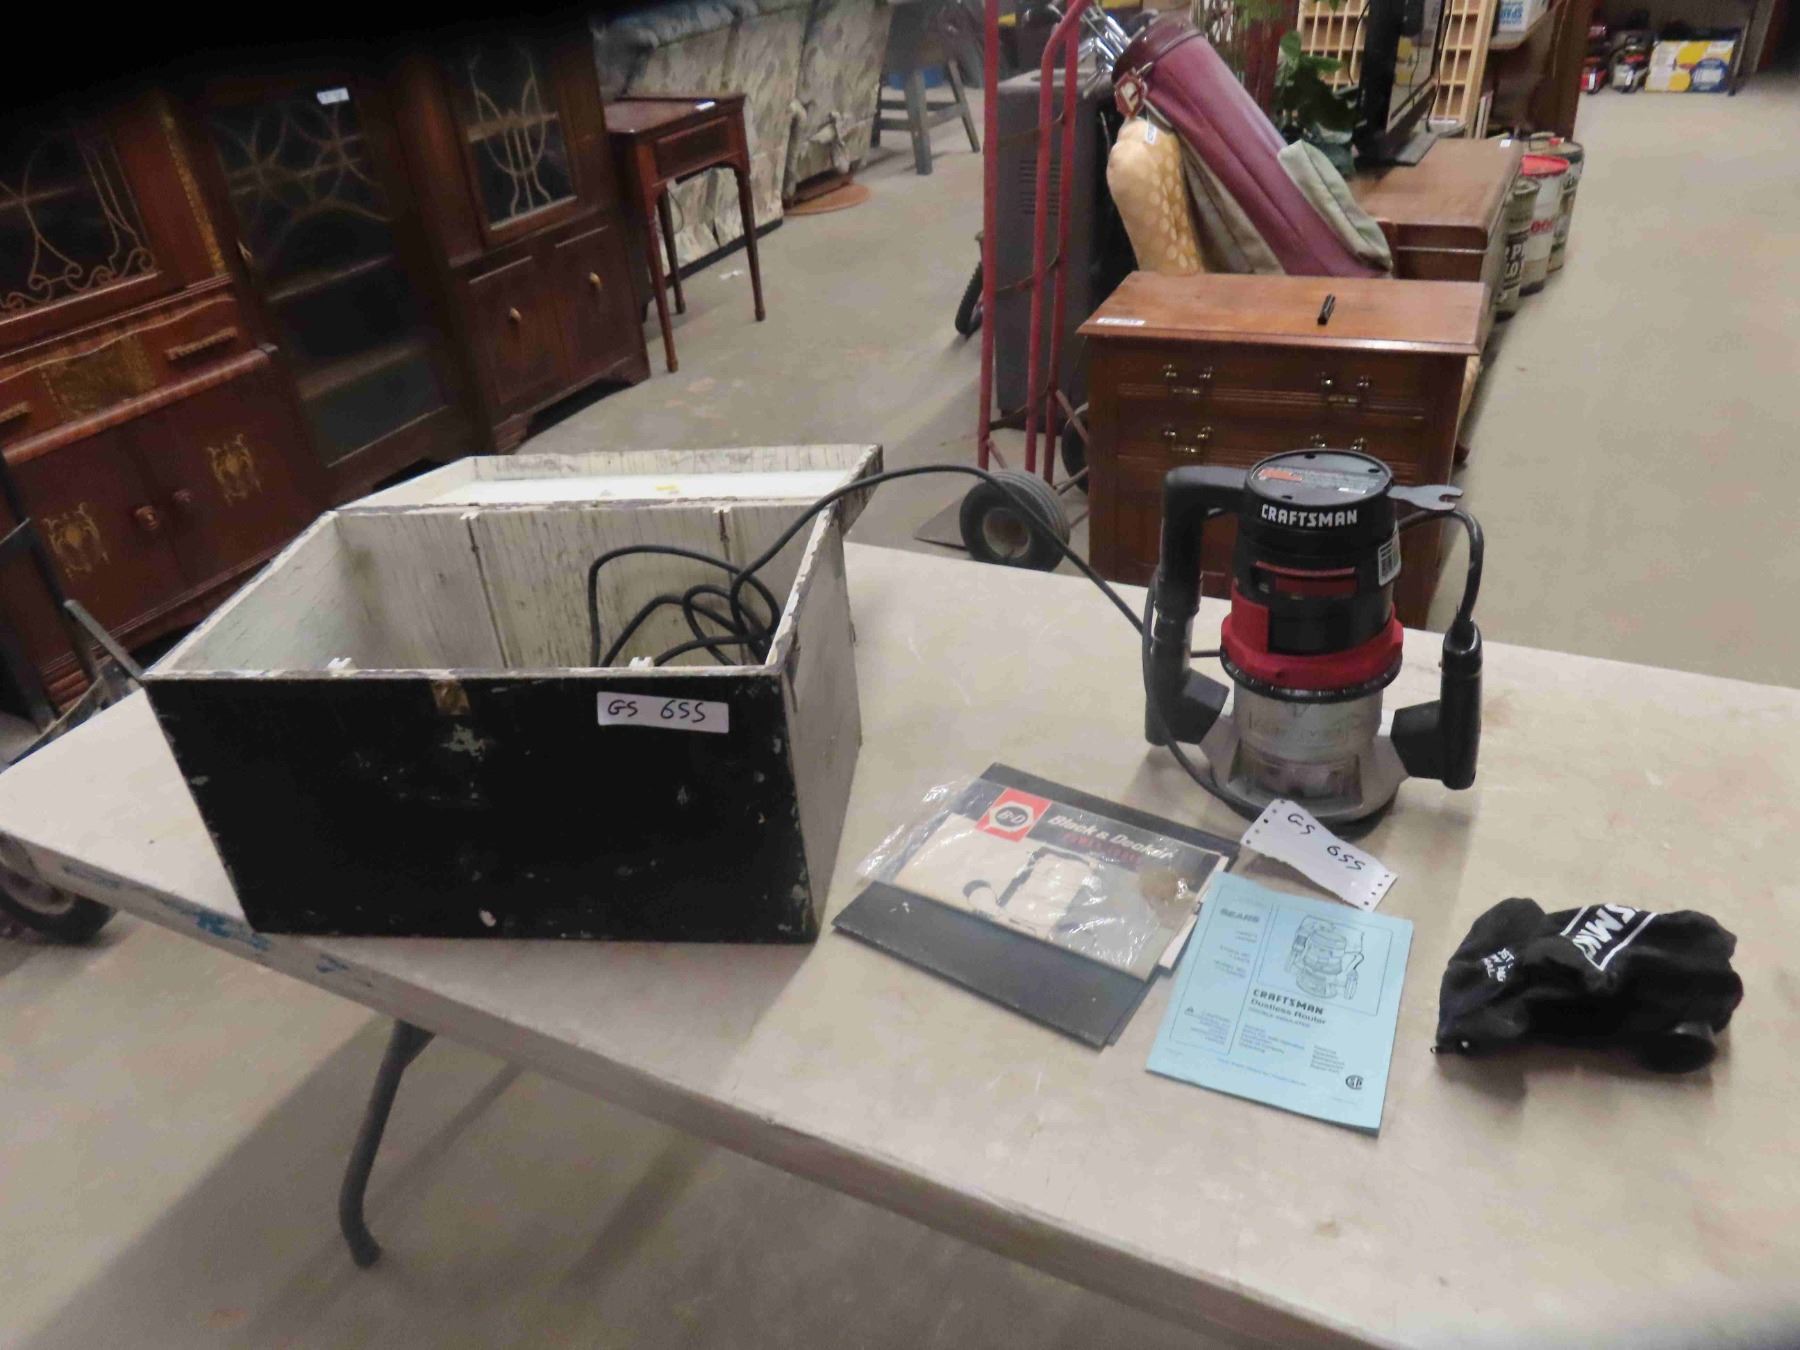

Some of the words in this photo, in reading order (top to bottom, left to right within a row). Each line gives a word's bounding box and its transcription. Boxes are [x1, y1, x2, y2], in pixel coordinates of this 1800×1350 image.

[1261, 503, 1358, 528] CRAFTSMAN
[607, 699, 638, 717] GS
[1048, 814, 1097, 837] Black
[1109, 833, 1177, 859] Decker
[1287, 812, 1316, 836] GS
[1251, 998, 1292, 1016] Dustless
[1294, 1011, 1326, 1025] Router
[1253, 988, 1324, 1015] CRAFTSMAN
